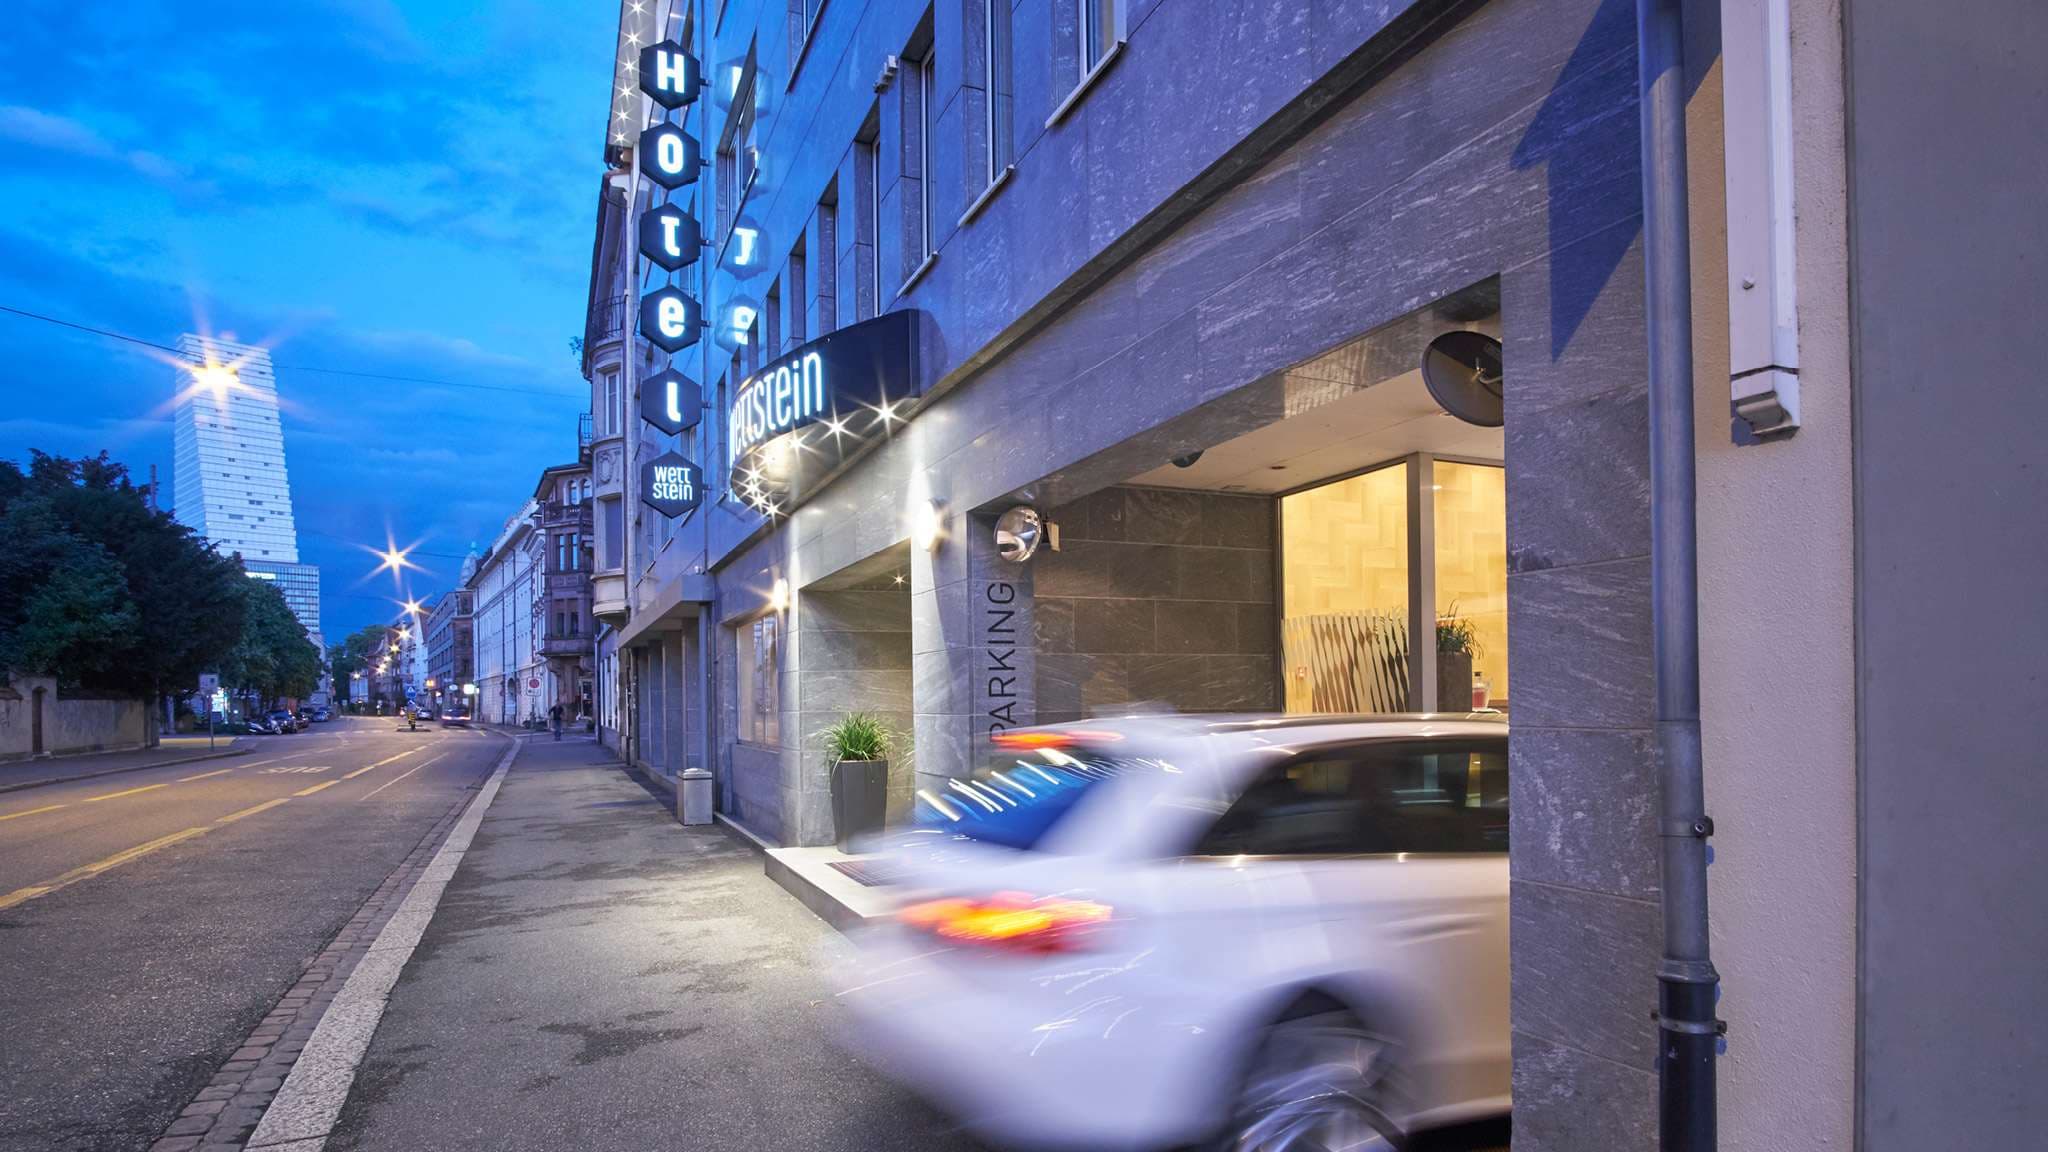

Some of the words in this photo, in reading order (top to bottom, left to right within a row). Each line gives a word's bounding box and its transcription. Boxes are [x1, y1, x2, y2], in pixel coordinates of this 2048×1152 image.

[656, 50, 686, 422] Hotel
[729, 351, 823, 467] ettstein
[653, 482, 693, 500] stein
[654, 465, 691, 484] wett
